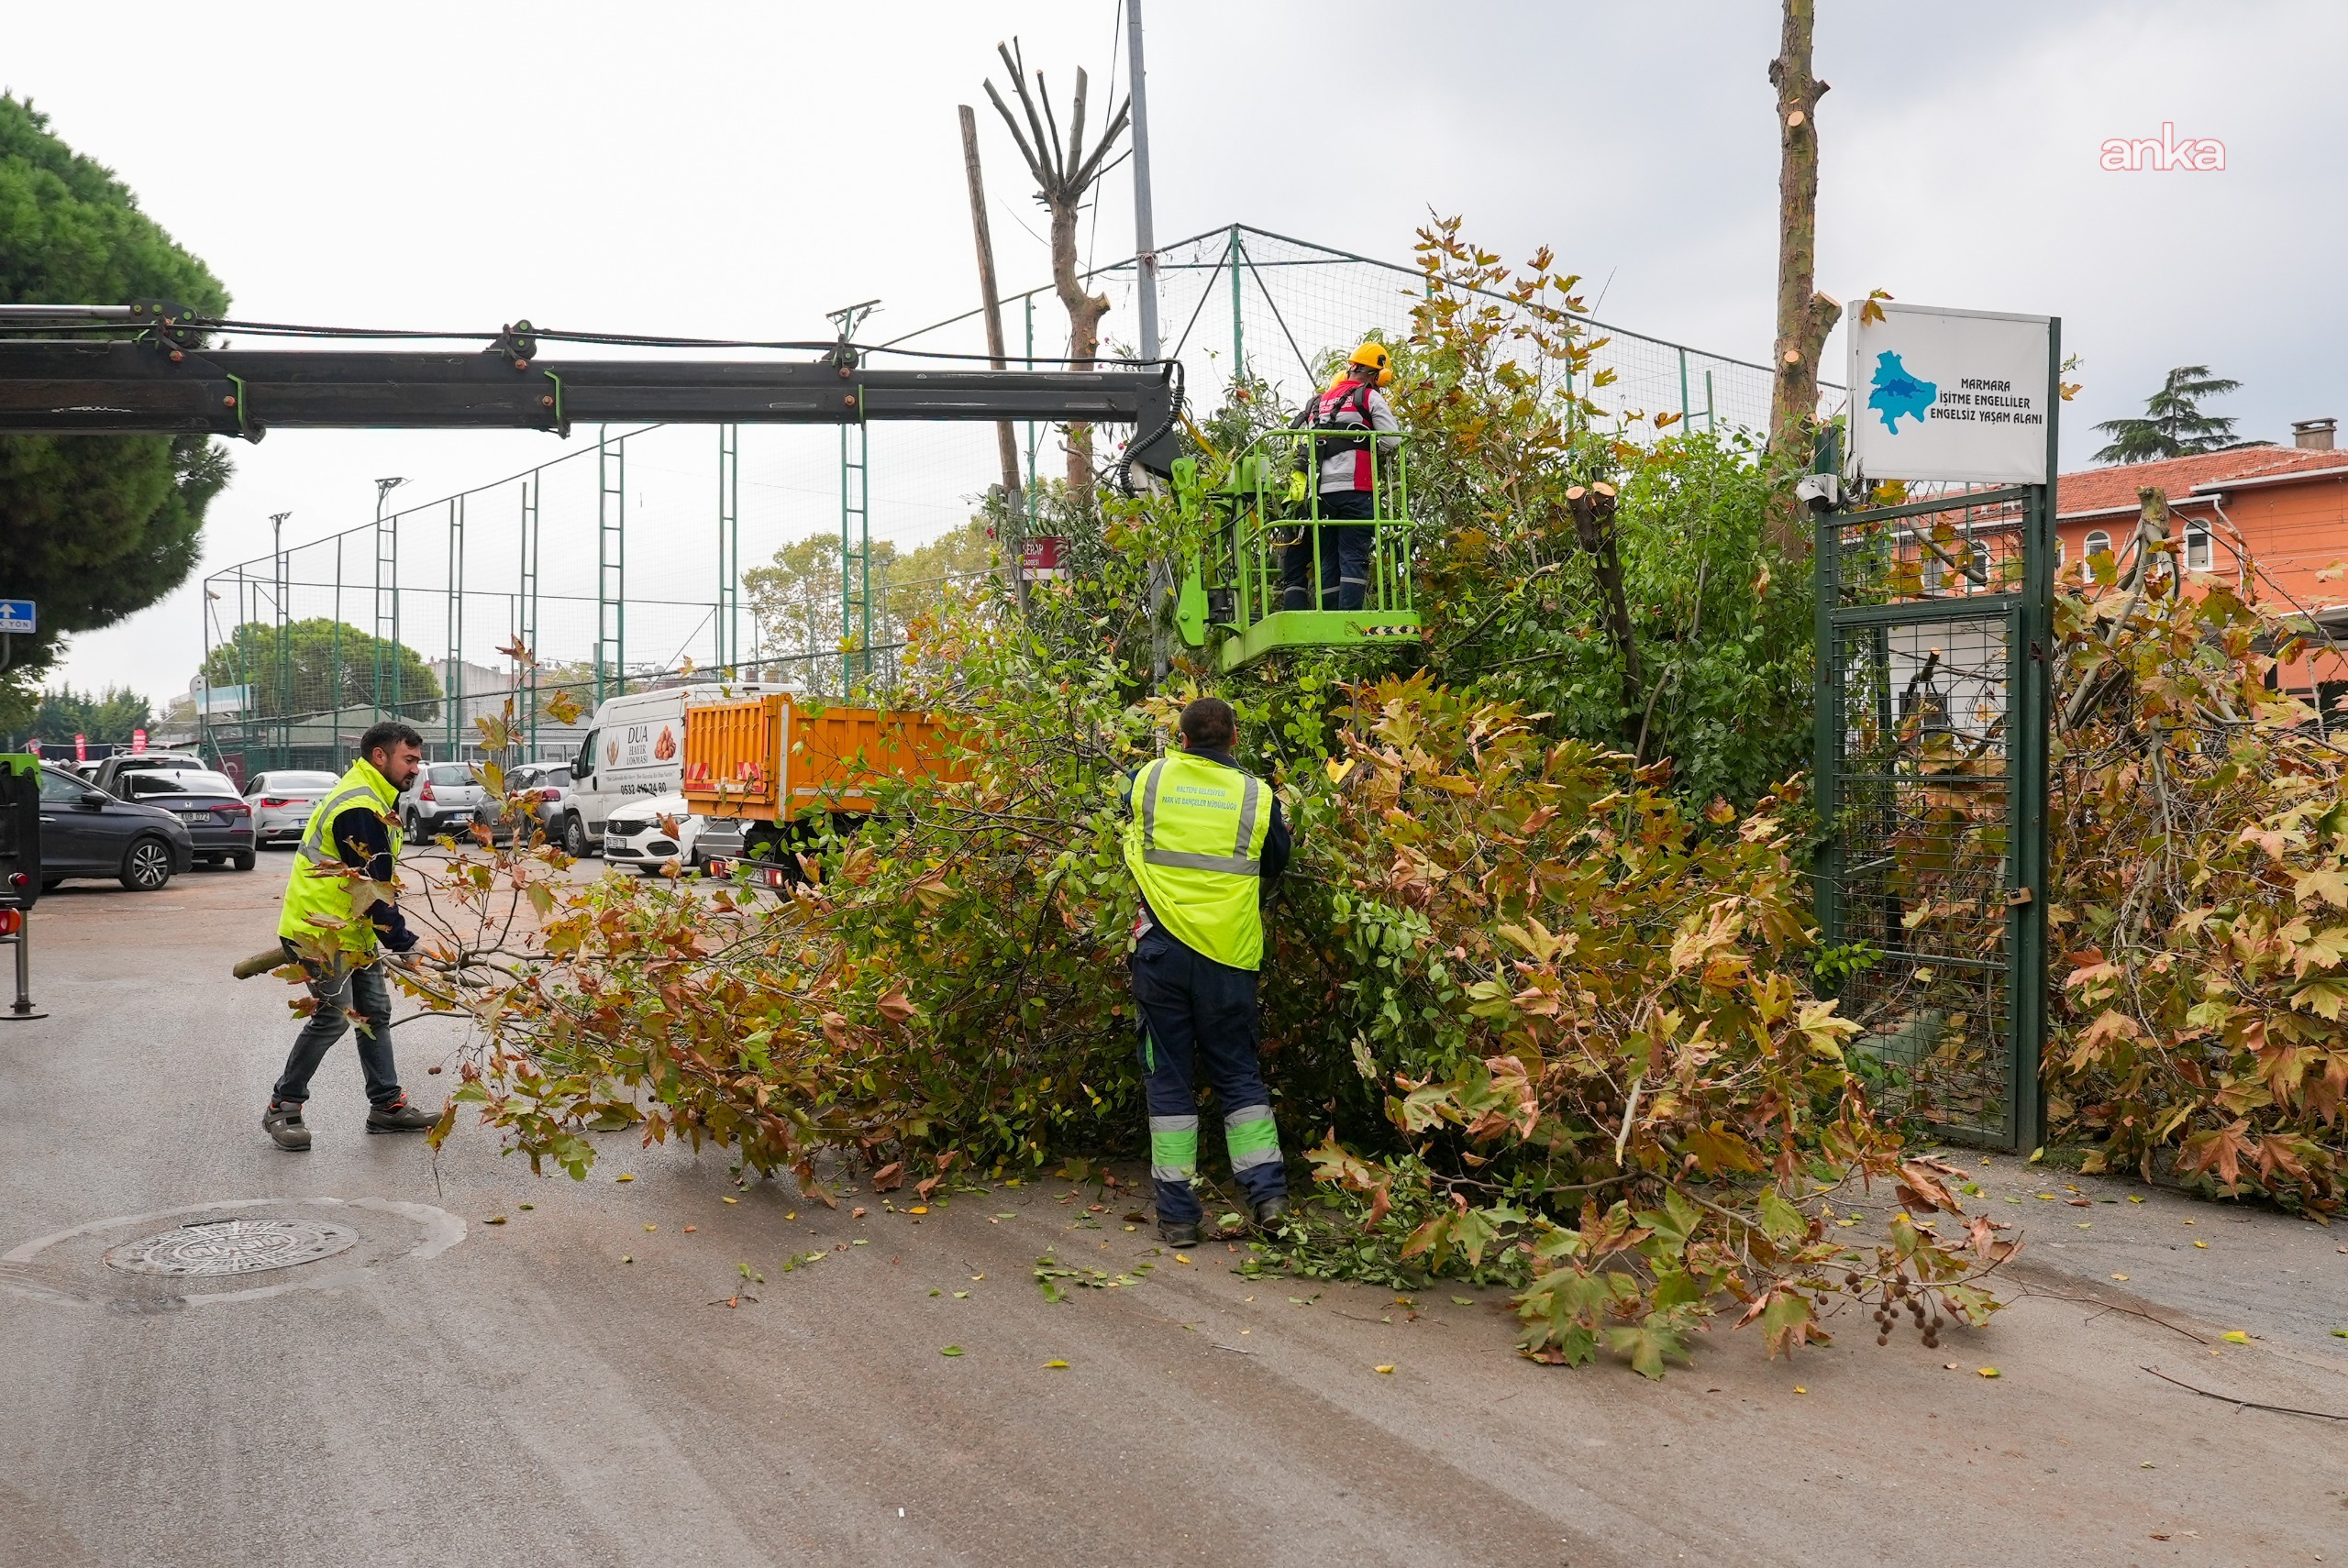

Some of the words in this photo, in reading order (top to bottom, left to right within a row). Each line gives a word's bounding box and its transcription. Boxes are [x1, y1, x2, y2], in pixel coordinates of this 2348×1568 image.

[1961, 378, 2010, 392] MARMARA
[1940, 390, 1971, 407] İŞİTME
[1975, 394, 2031, 409] ENGELLİLER
[1931, 407, 1976, 421] ENGELSİZ
[1979, 410, 2010, 425] YAŞAM
[2013, 413, 2043, 425] ALANI
[628, 725, 648, 744] DUA
[629, 745, 647, 756] HAYIR
[626, 756, 648, 765] LOKMASI
[621, 784, 636, 795] 0532
